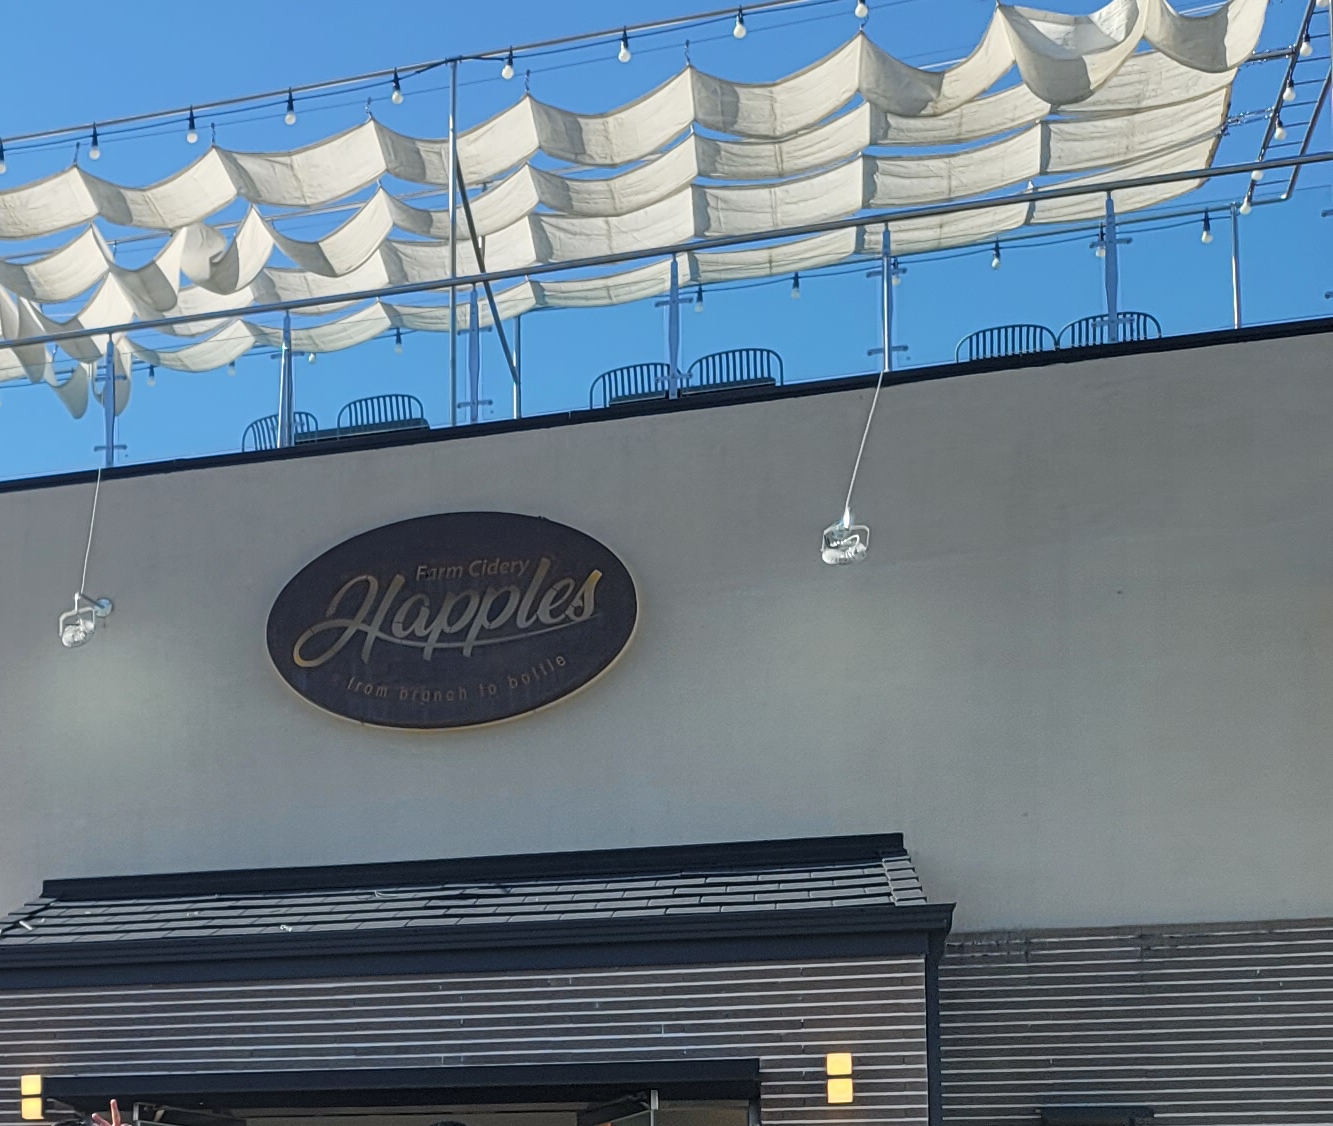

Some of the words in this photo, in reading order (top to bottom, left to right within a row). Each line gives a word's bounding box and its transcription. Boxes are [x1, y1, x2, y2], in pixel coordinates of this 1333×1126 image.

[416, 564, 463, 581] Farm
[468, 557, 530, 578] Cidery
[292, 557, 603, 668] Happles
[347, 677, 388, 697] from
[480, 684, 497, 695] to
[507, 655, 567, 689] bottle
